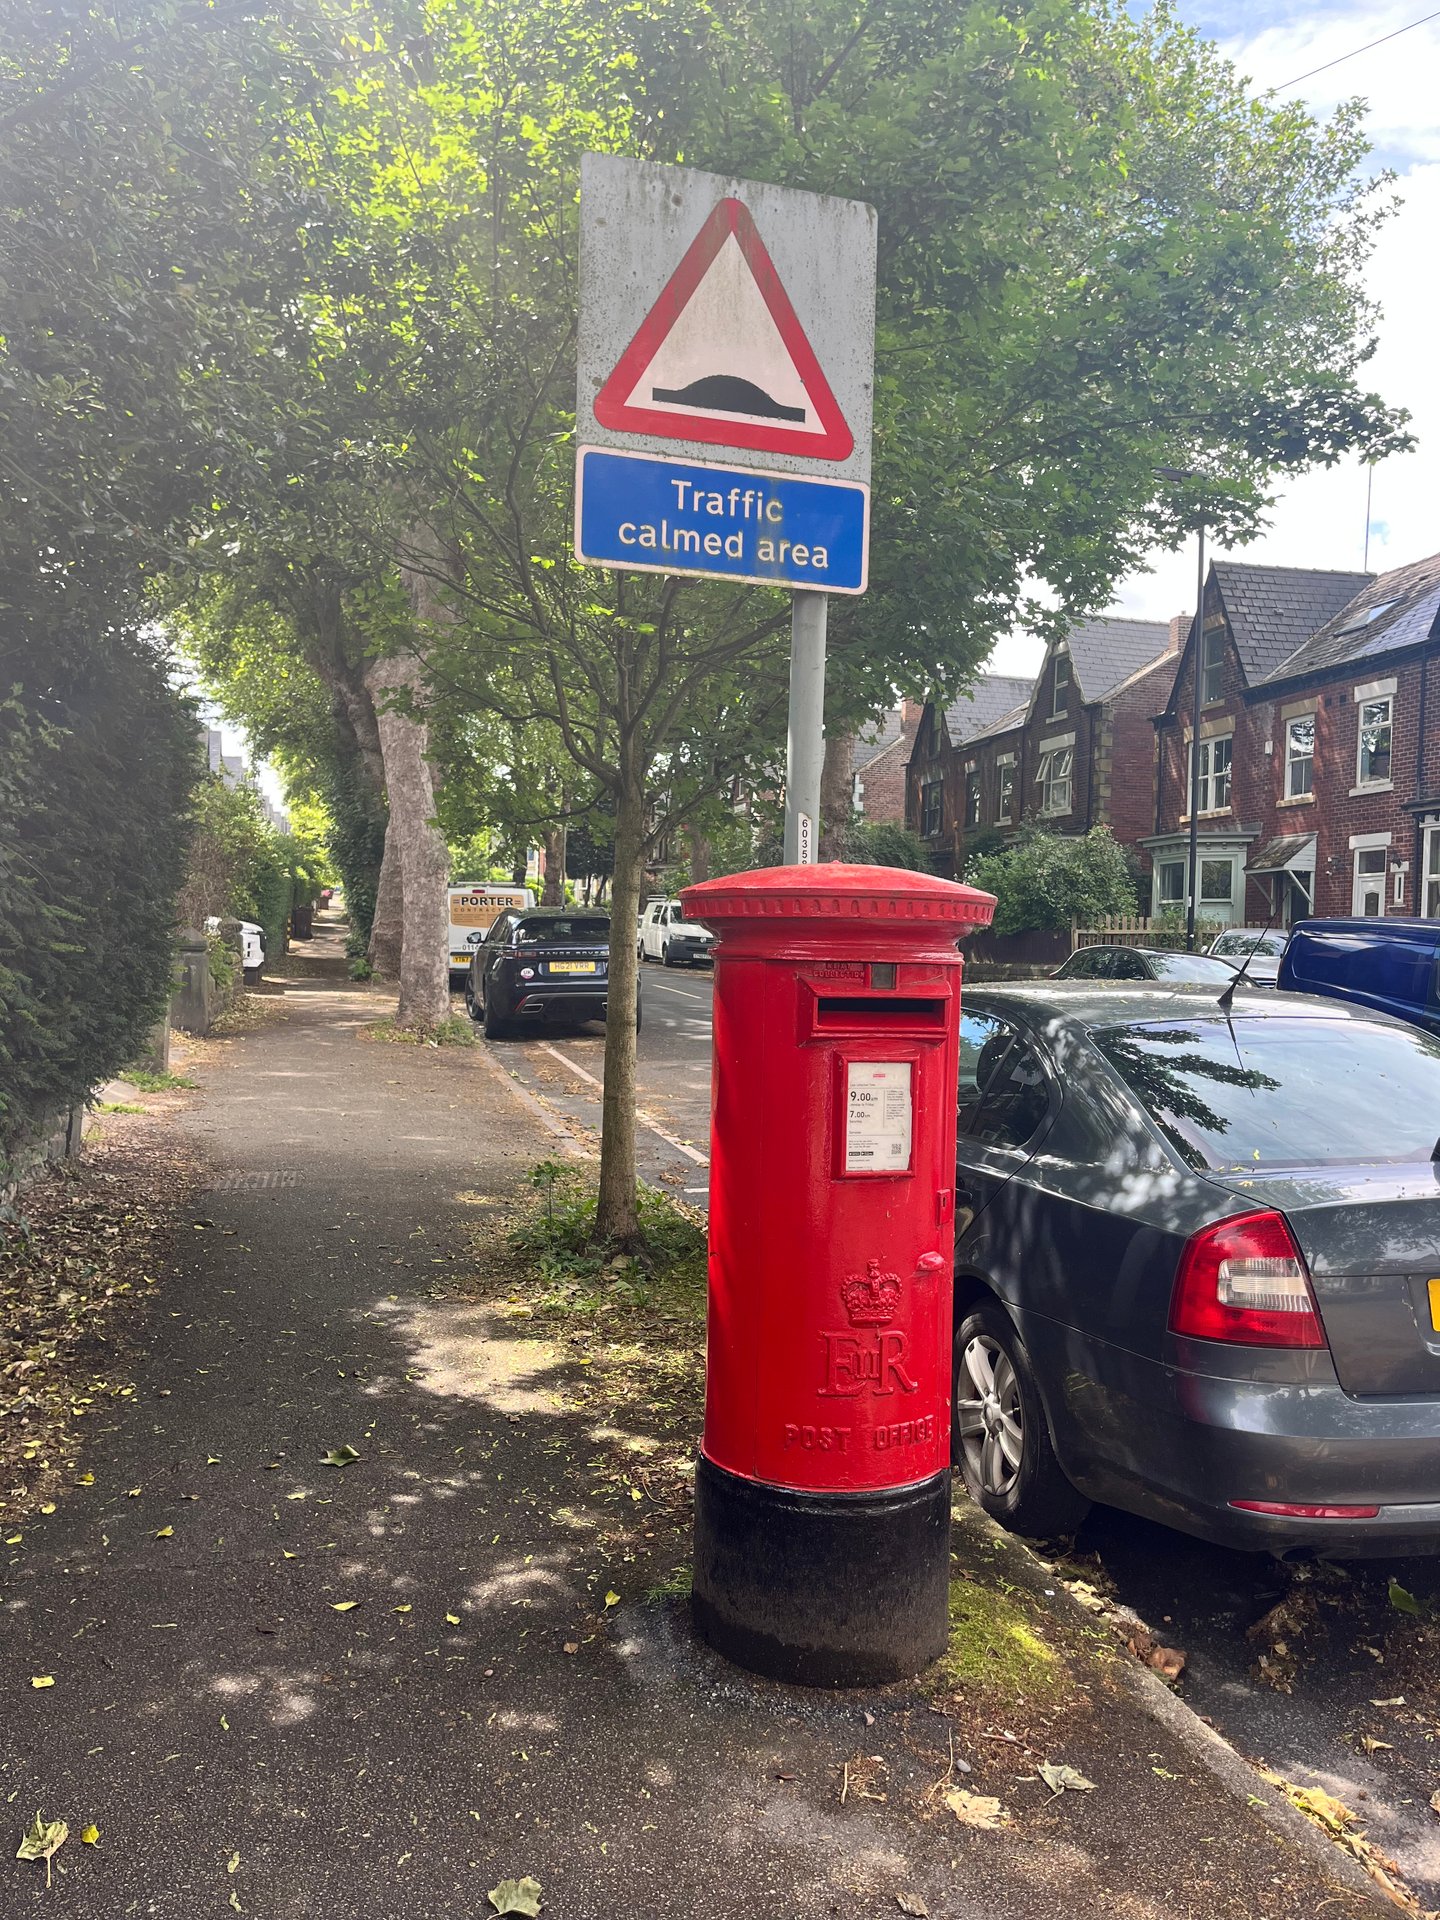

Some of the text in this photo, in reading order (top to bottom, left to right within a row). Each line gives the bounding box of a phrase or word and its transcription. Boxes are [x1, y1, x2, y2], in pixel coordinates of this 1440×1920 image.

[671, 479, 783, 523] Traffic
[618, 519, 829, 569] calmed area
[461, 896, 513, 906] PORTER
[813, 969, 865, 978] COLLECTION
[784, 1414, 934, 1453] POST OFFICE
